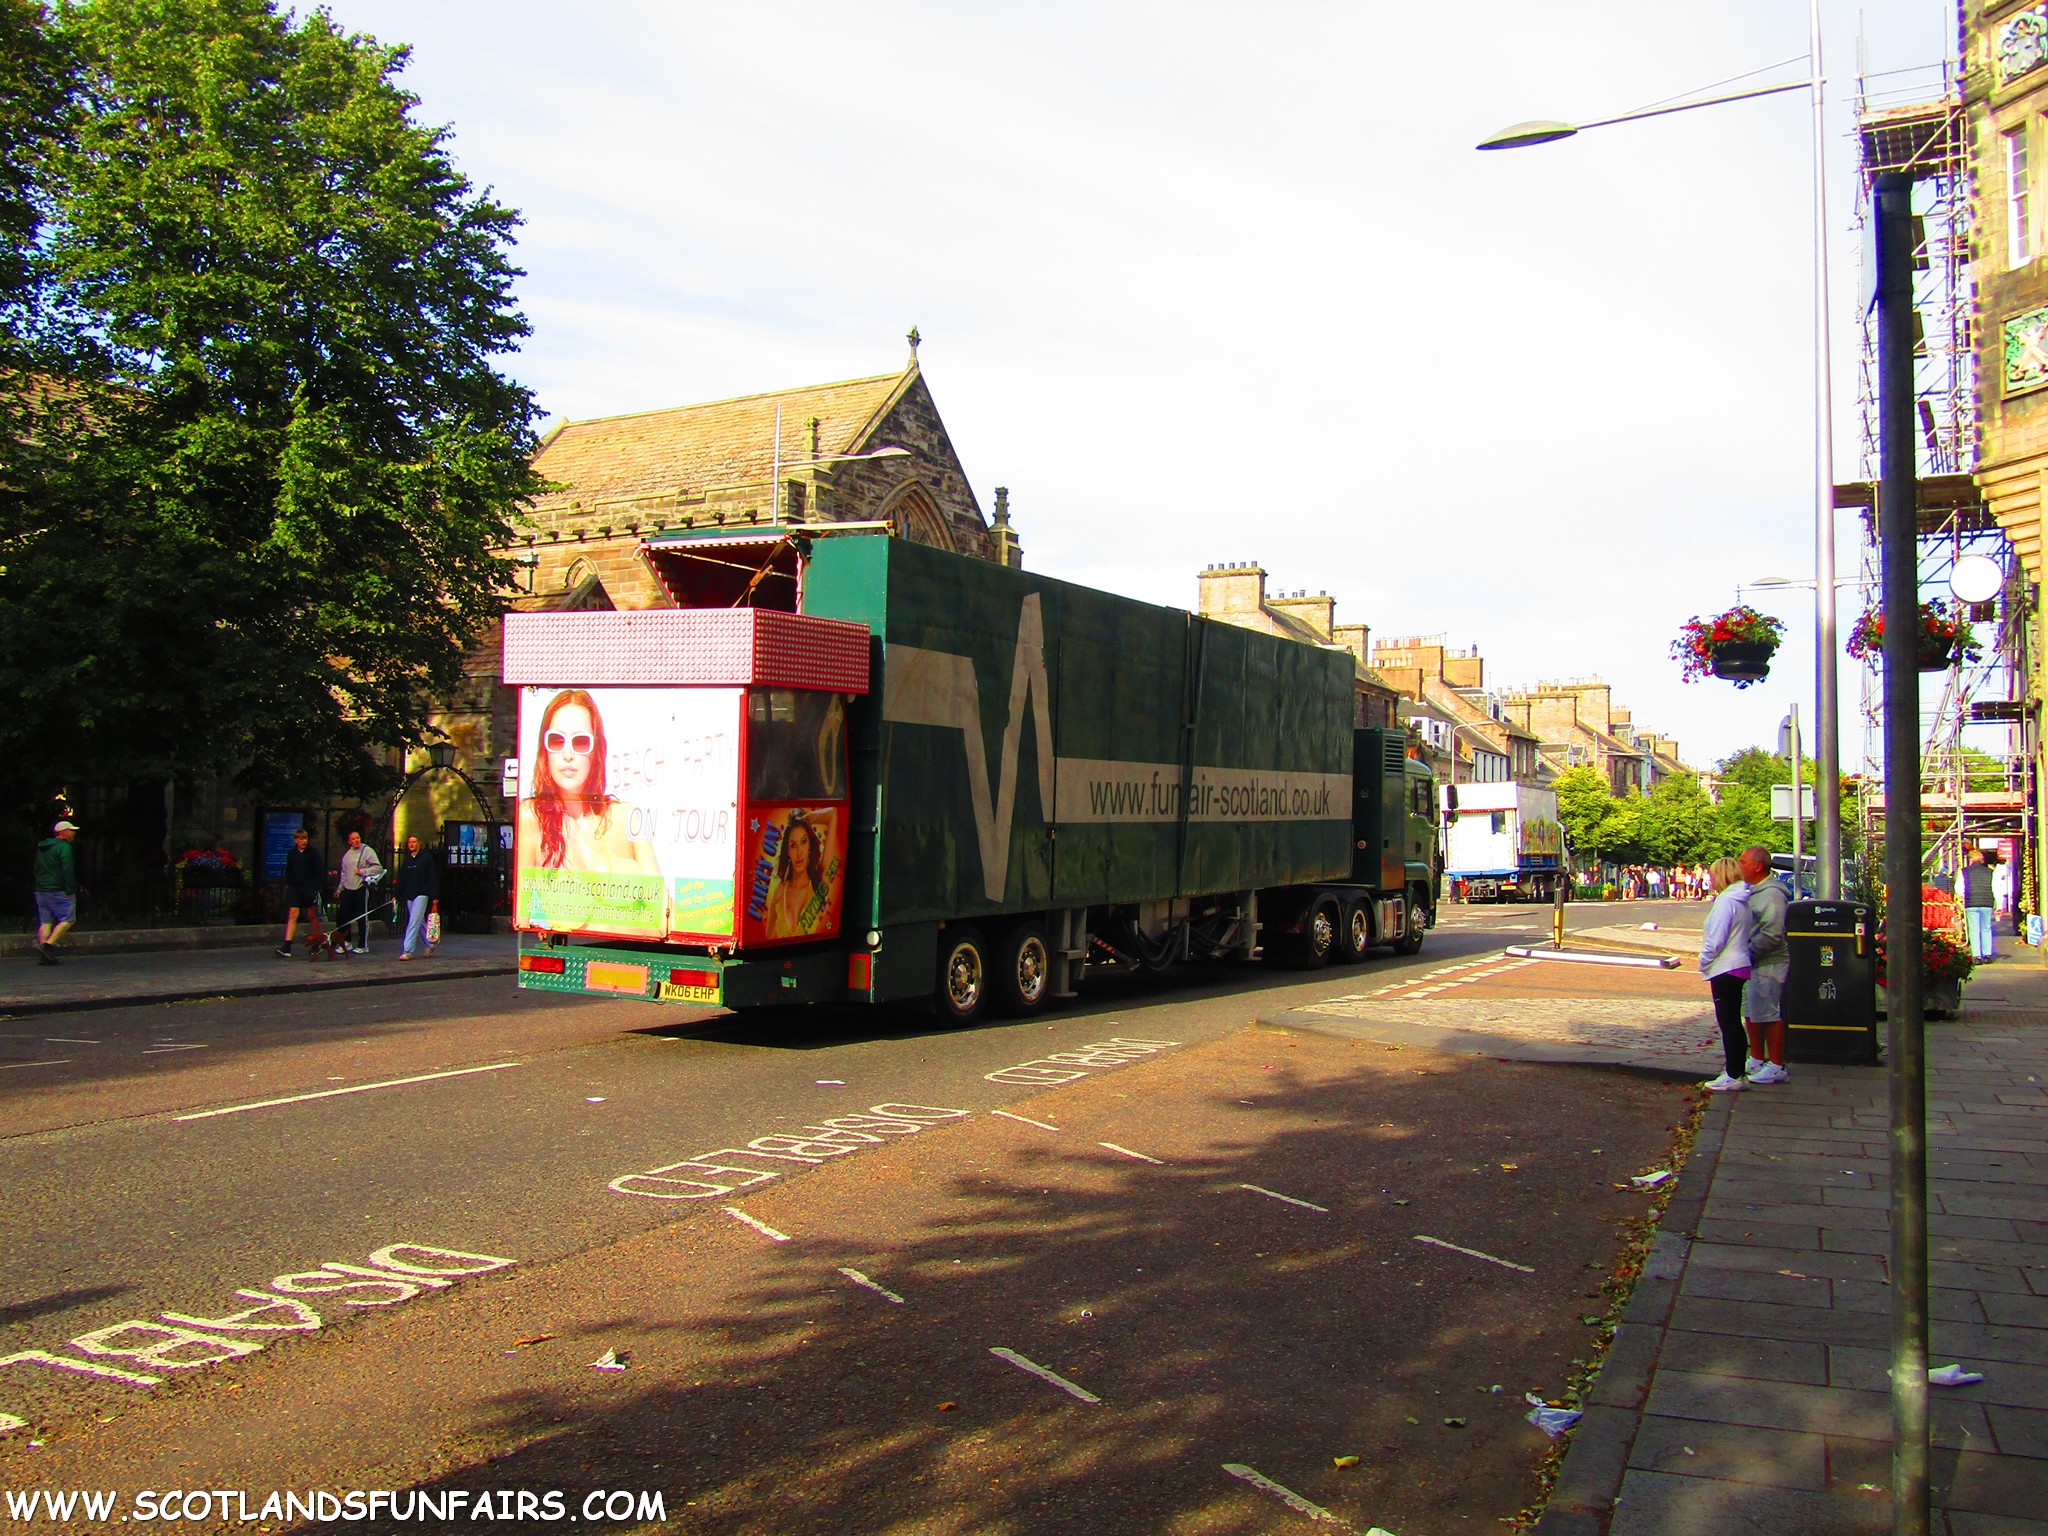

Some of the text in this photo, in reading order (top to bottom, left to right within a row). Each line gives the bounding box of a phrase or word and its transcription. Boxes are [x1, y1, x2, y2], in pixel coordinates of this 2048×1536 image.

[1090, 771, 1330, 816] www.funair-scotland.co.uk
[628, 807, 729, 841] ON TOUR
[522, 872, 660, 900] www.funfair-scotland.co.uk
[747, 858, 774, 922] PARTY
[664, 984, 715, 1000] WK06 EHP
[983, 1037, 1182, 1087] DISABLED
[608, 1103, 972, 1200] DISABLED
[0, 1242, 518, 1431] DISABL
